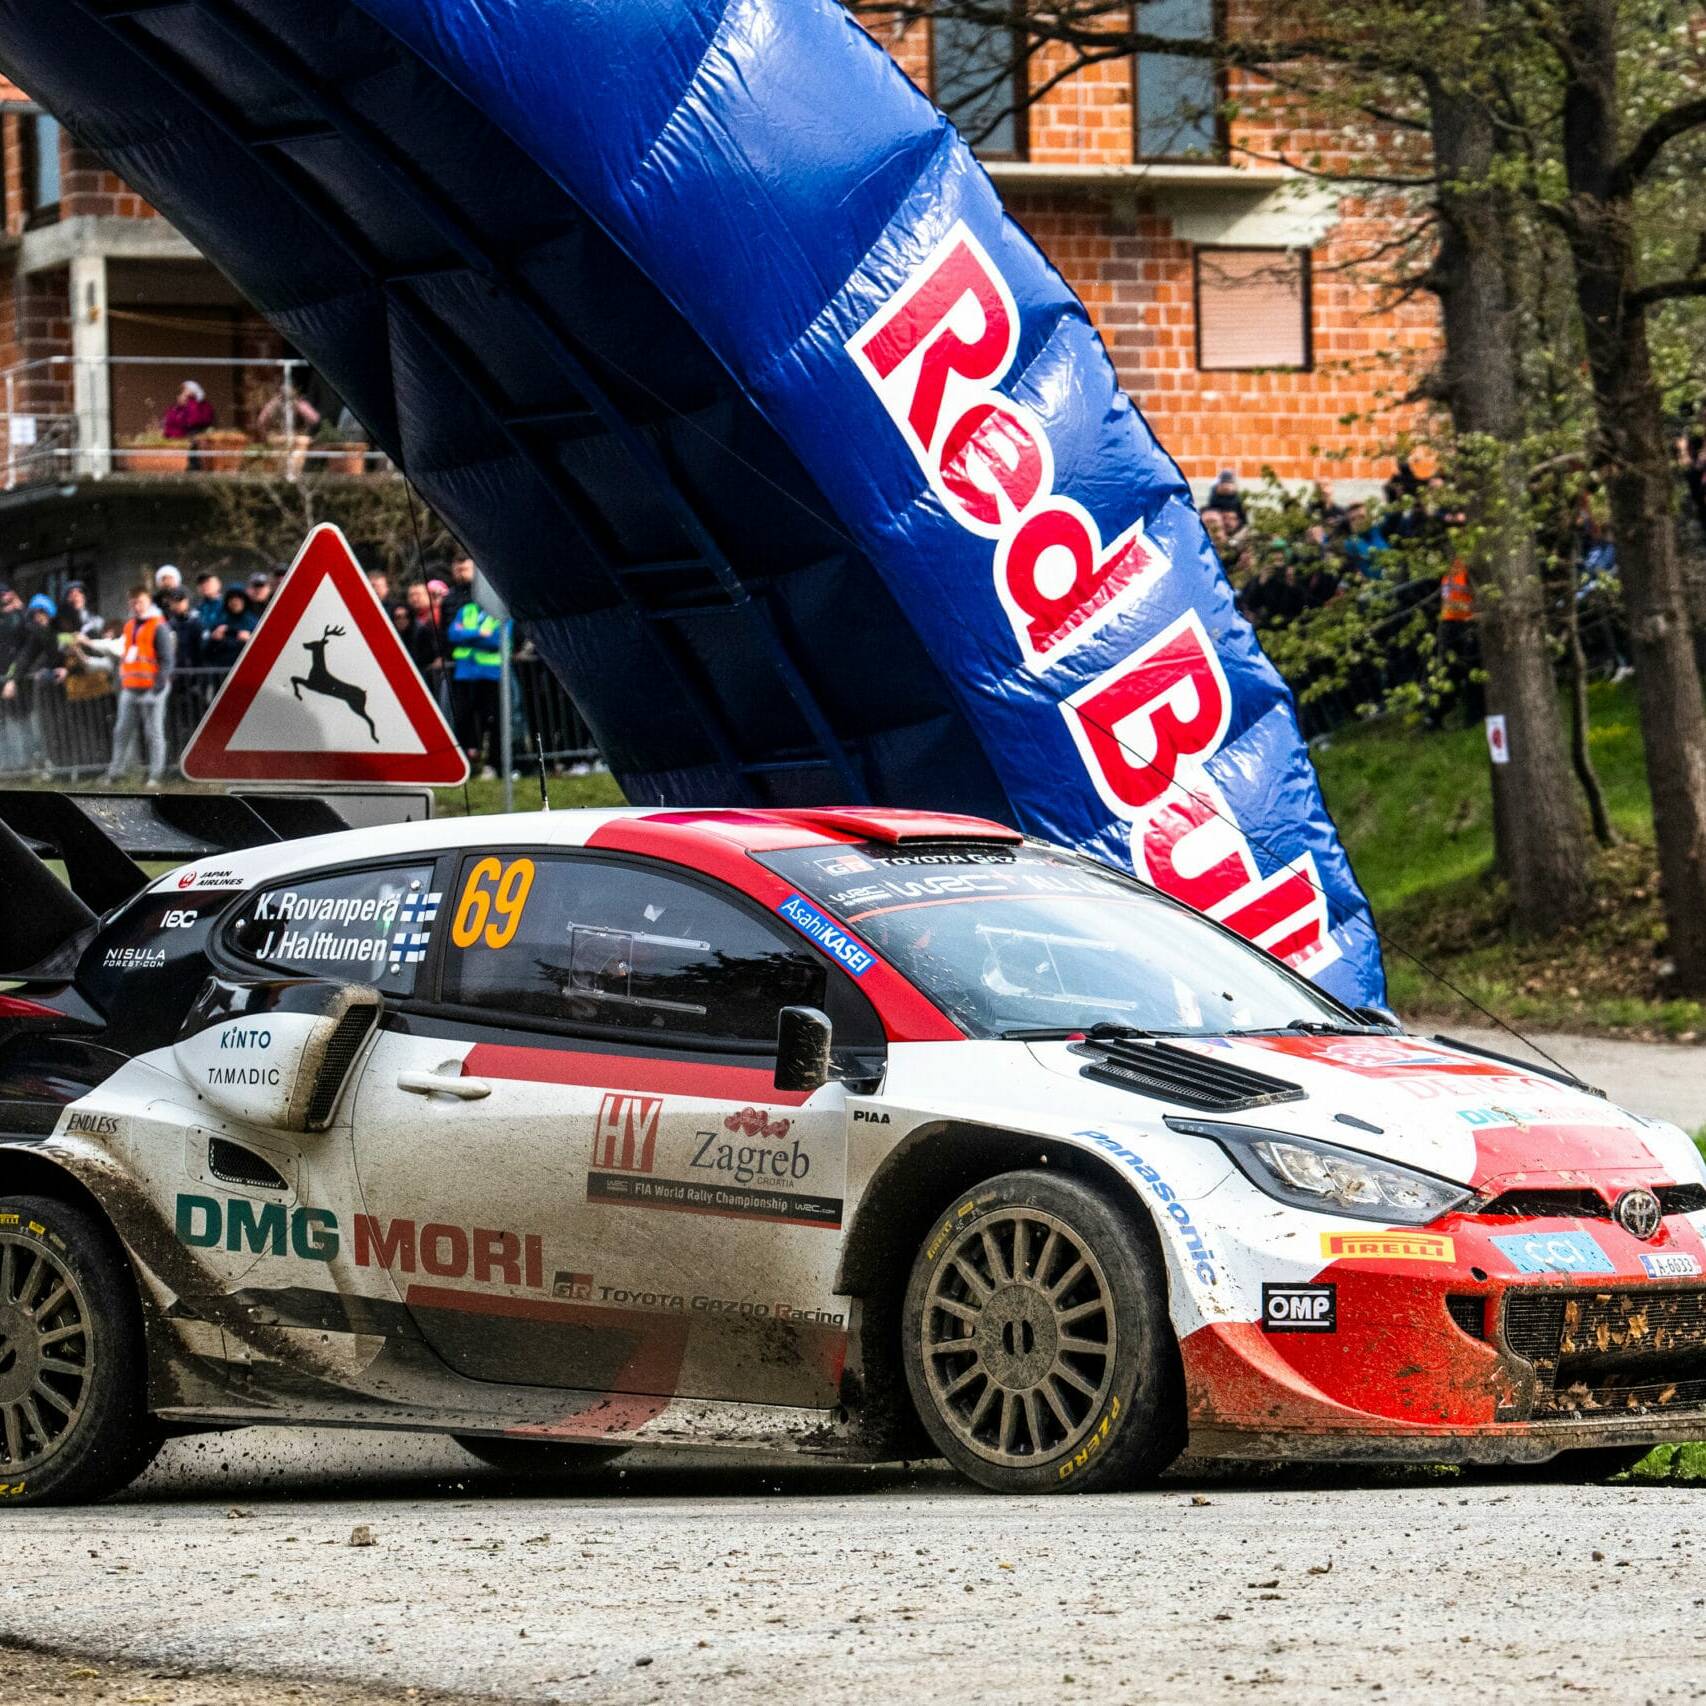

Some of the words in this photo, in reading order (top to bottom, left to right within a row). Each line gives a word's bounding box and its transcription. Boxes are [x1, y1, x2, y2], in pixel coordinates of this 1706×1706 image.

[847, 221, 1169, 671] Red
[872, 853, 966, 867] TOYOTA
[196, 878, 244, 886] AIRLINES
[199, 870, 233, 879] JAPAN
[254, 892, 403, 926] K.Rovanperä
[451, 857, 535, 949] 69
[105, 948, 166, 960] NISULA
[256, 931, 388, 960] J.Halttunen
[208, 1067, 280, 1086] TAMADIC
[67, 1113, 120, 1134] ENDLESS
[853, 1110, 890, 1124] PIAA
[593, 1095, 660, 1171] HY
[689, 1130, 810, 1184] Zagreb
[757, 1176, 795, 1188] CROATIA
[635, 1182, 652, 1196] FIA
[655, 1185, 685, 1200] World
[687, 1188, 714, 1204] Rally
[715, 1191, 788, 1212] Championship
[1071, 1130, 1217, 1286] Panasonic
[175, 1193, 341, 1262] DMG
[353, 1213, 544, 1288] MORI
[1330, 1235, 1444, 1257] PIRELLI
[598, 1286, 685, 1309] TOYOTA
[774, 1302, 845, 1327] Racing
[1268, 1296, 1330, 1320] OMP
